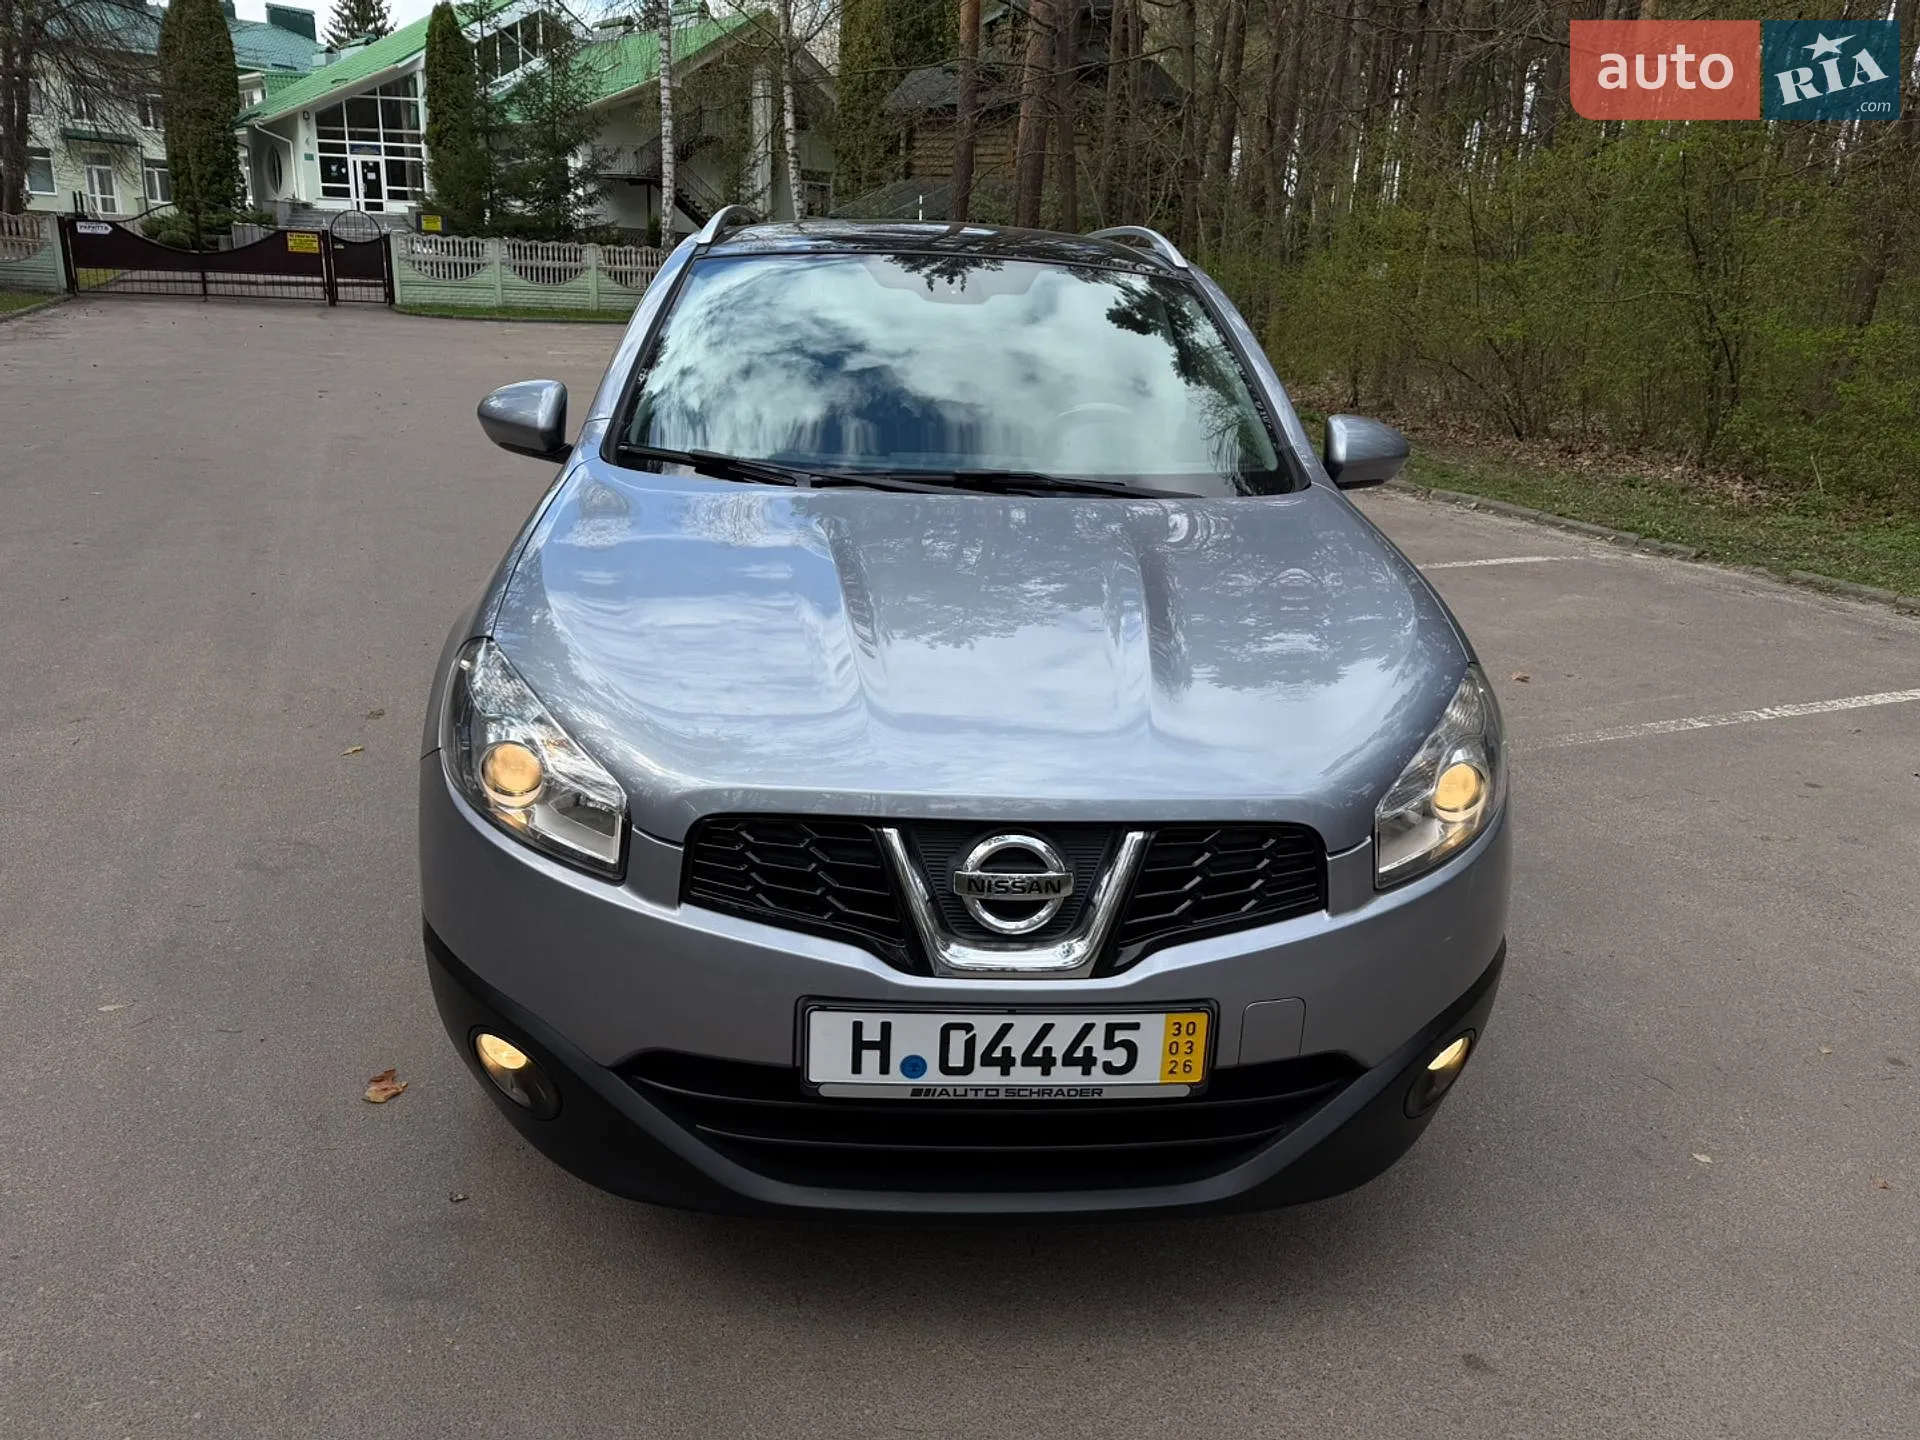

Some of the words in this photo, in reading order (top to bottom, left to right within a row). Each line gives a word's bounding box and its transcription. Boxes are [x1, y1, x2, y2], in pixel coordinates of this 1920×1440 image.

[967, 877, 1061, 895] NISSAN
[1171, 1021, 1196, 1036] 30
[851, 1020, 892, 1075] H
[939, 1022, 1141, 1076] 04445
[1168, 1040, 1194, 1055] 03
[1167, 1060, 1192, 1074] 26
[937, 1088, 1000, 1098] AUTO
[1004, 1088, 1104, 1098] SCHRADER
